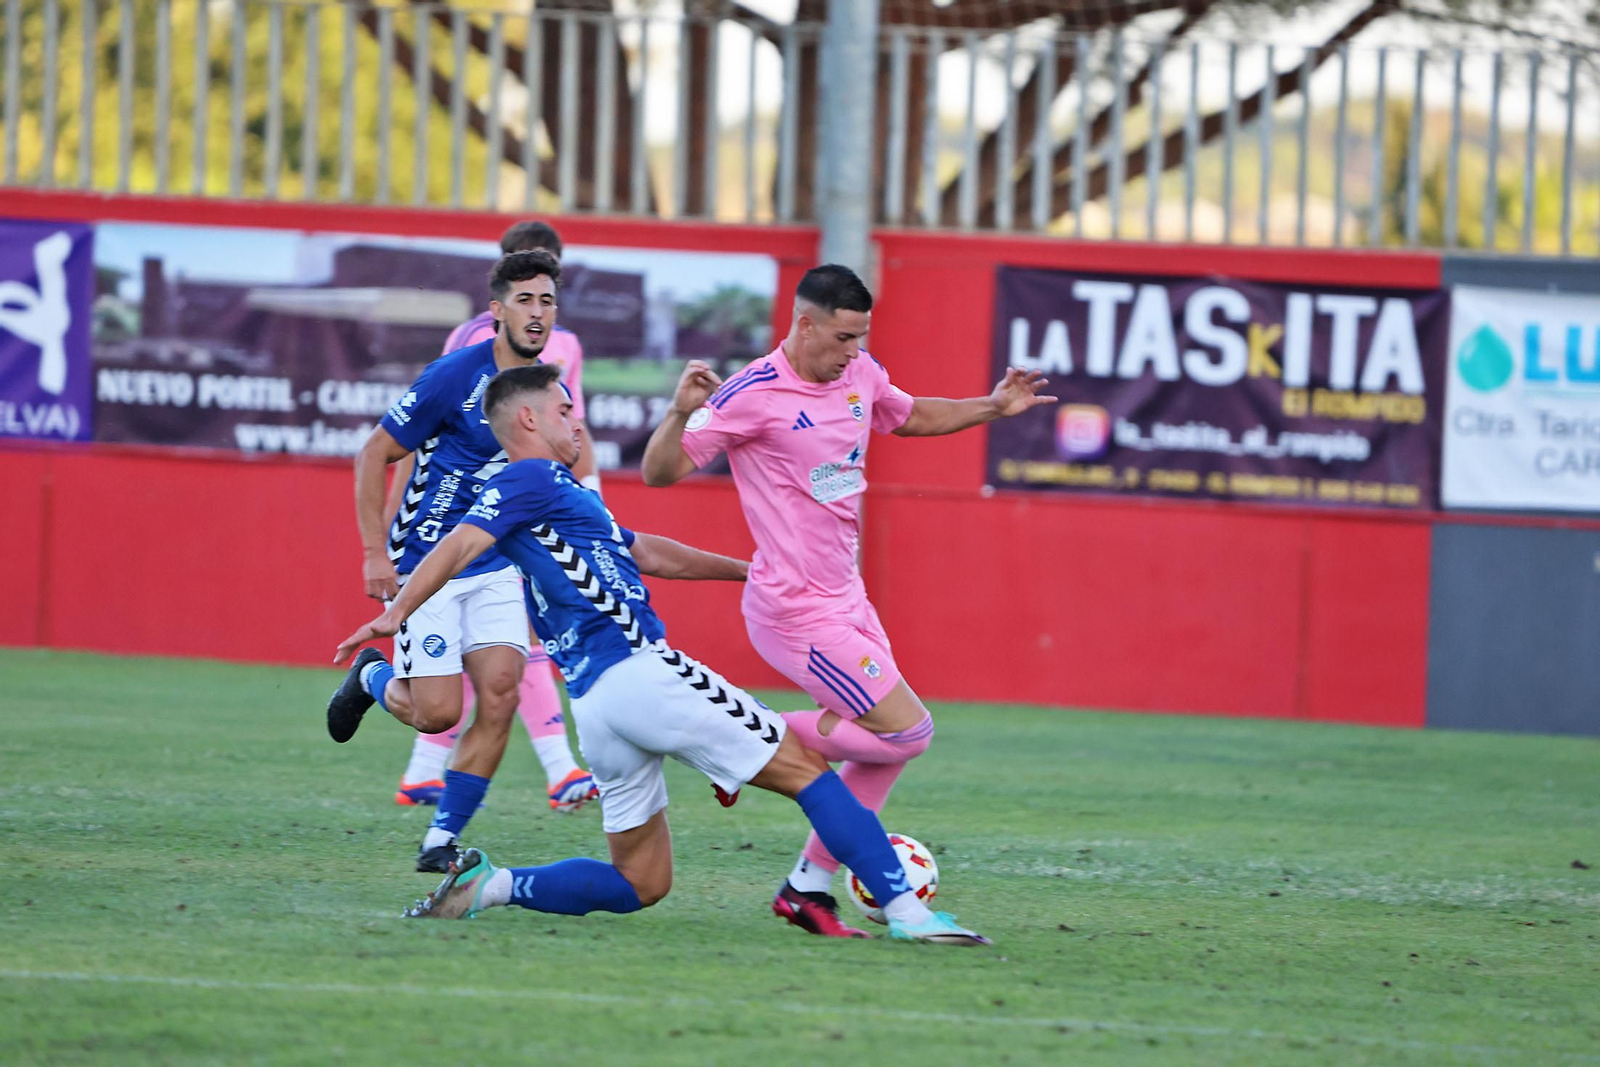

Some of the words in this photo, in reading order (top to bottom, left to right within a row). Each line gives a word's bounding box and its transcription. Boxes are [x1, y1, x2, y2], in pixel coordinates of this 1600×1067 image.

[1009, 317, 1074, 375] LA
[97, 368, 194, 407] NUEVO
[198, 373, 294, 412] PORTIL
